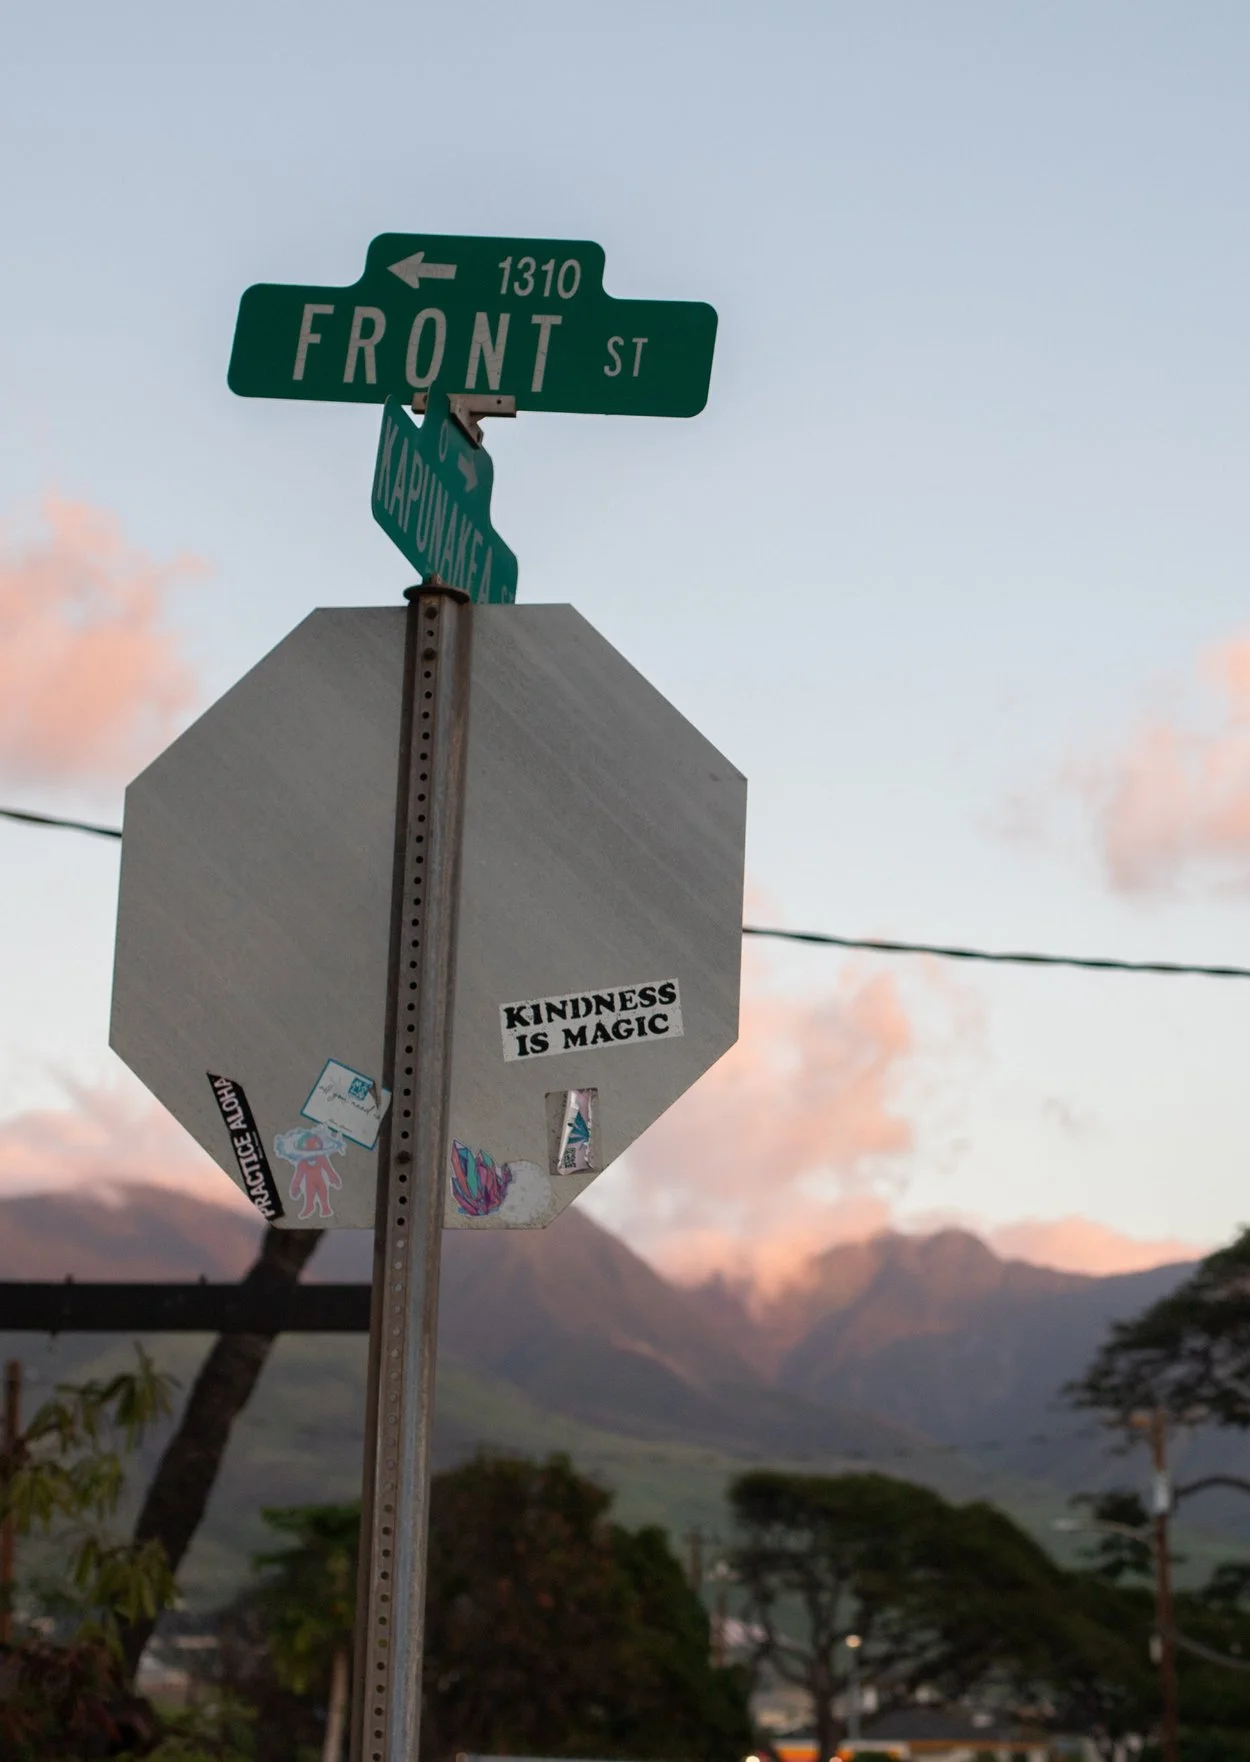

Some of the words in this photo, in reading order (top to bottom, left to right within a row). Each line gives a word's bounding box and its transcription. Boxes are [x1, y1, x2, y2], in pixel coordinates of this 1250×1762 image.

[497, 256, 582, 299] 1310
[292, 304, 563, 393] FRONT
[603, 335, 649, 378] ST
[376, 415, 493, 604] KAPUNAKEA
[504, 982, 678, 1029] KINDNESS
[516, 1032, 550, 1057] IS
[562, 1013, 670, 1050] MAGIC
[213, 1077, 248, 1131] ALOHA
[234, 1131, 276, 1218] PRACTICE
